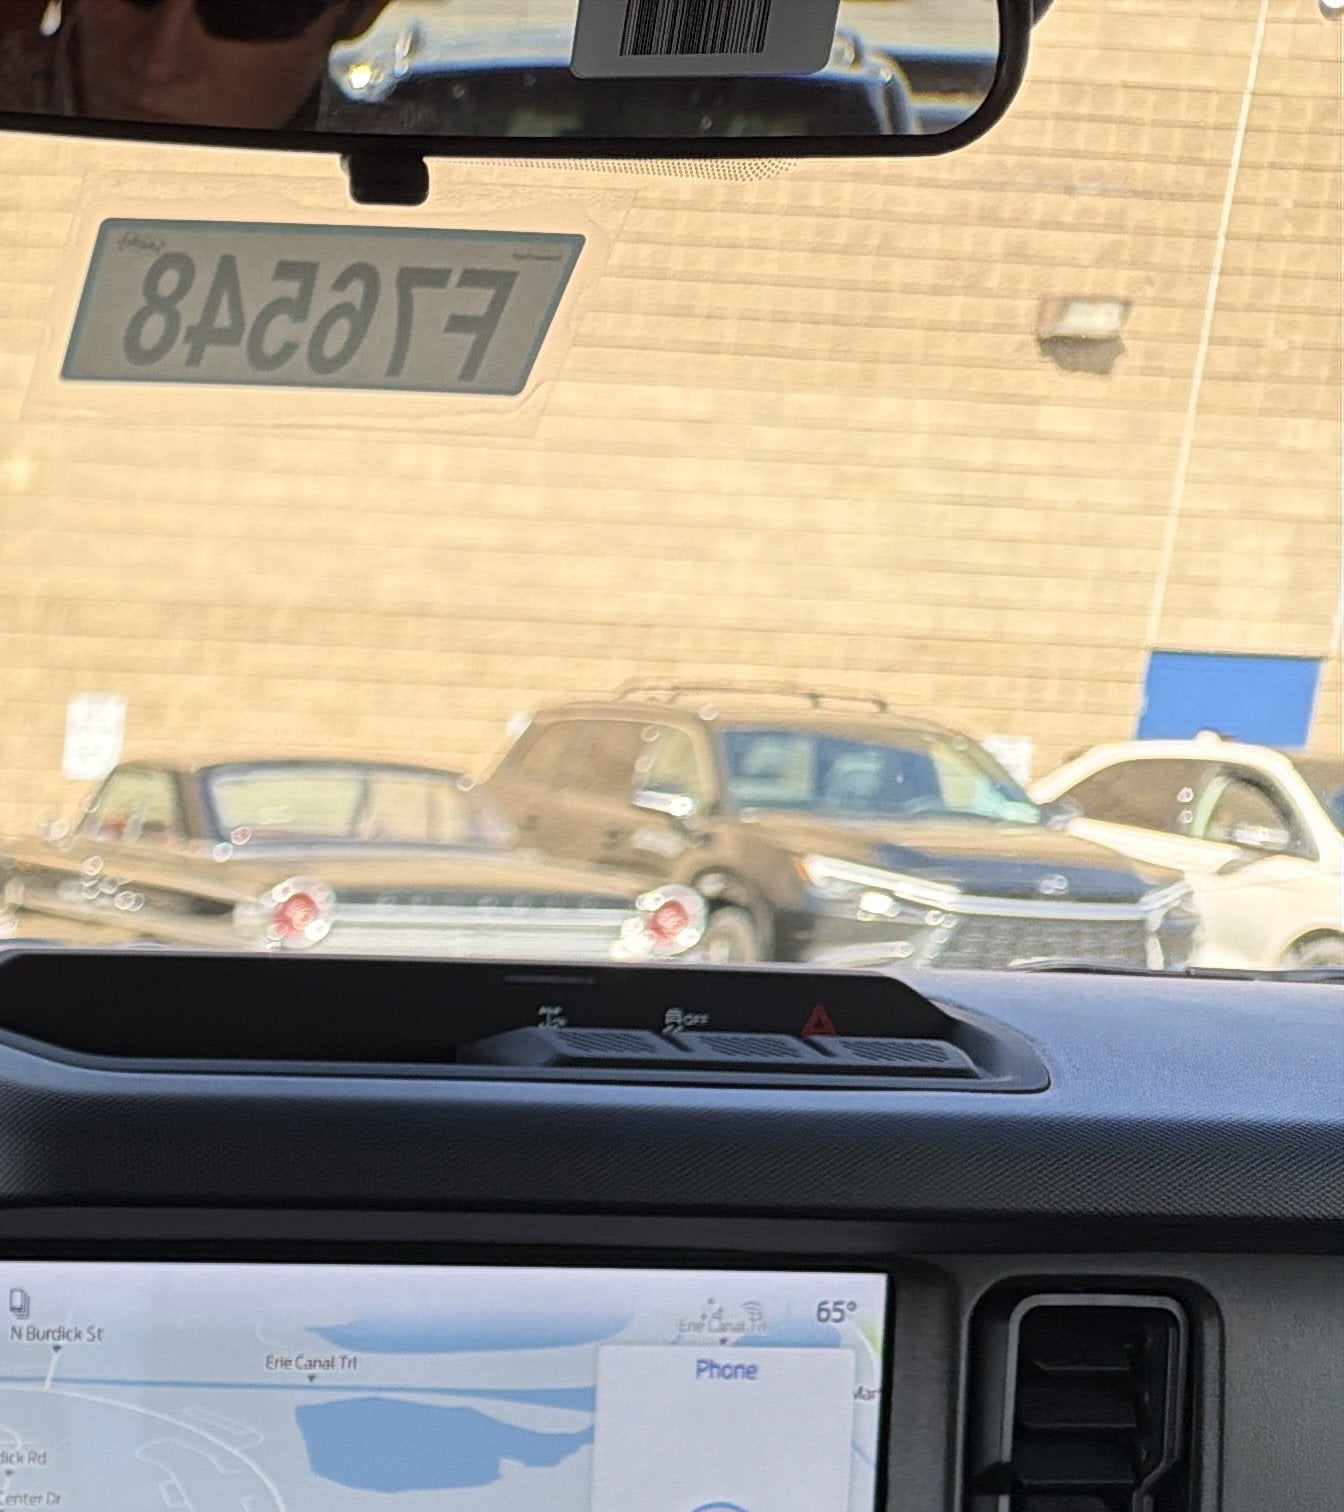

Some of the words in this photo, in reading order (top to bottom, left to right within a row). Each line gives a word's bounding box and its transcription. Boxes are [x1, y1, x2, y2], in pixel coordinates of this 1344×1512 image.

[816, 1300, 857, 1323] 65°
[10, 1326, 22, 1341] N
[25, 1325, 82, 1342] Burdick
[85, 1325, 103, 1342] St
[265, 1356, 293, 1370] Erie
[295, 1355, 335, 1371] Canal
[695, 1358, 759, 1380] Phone
[27, 1450, 47, 1465] Rd
[46, 1491, 61, 1506] Dr
